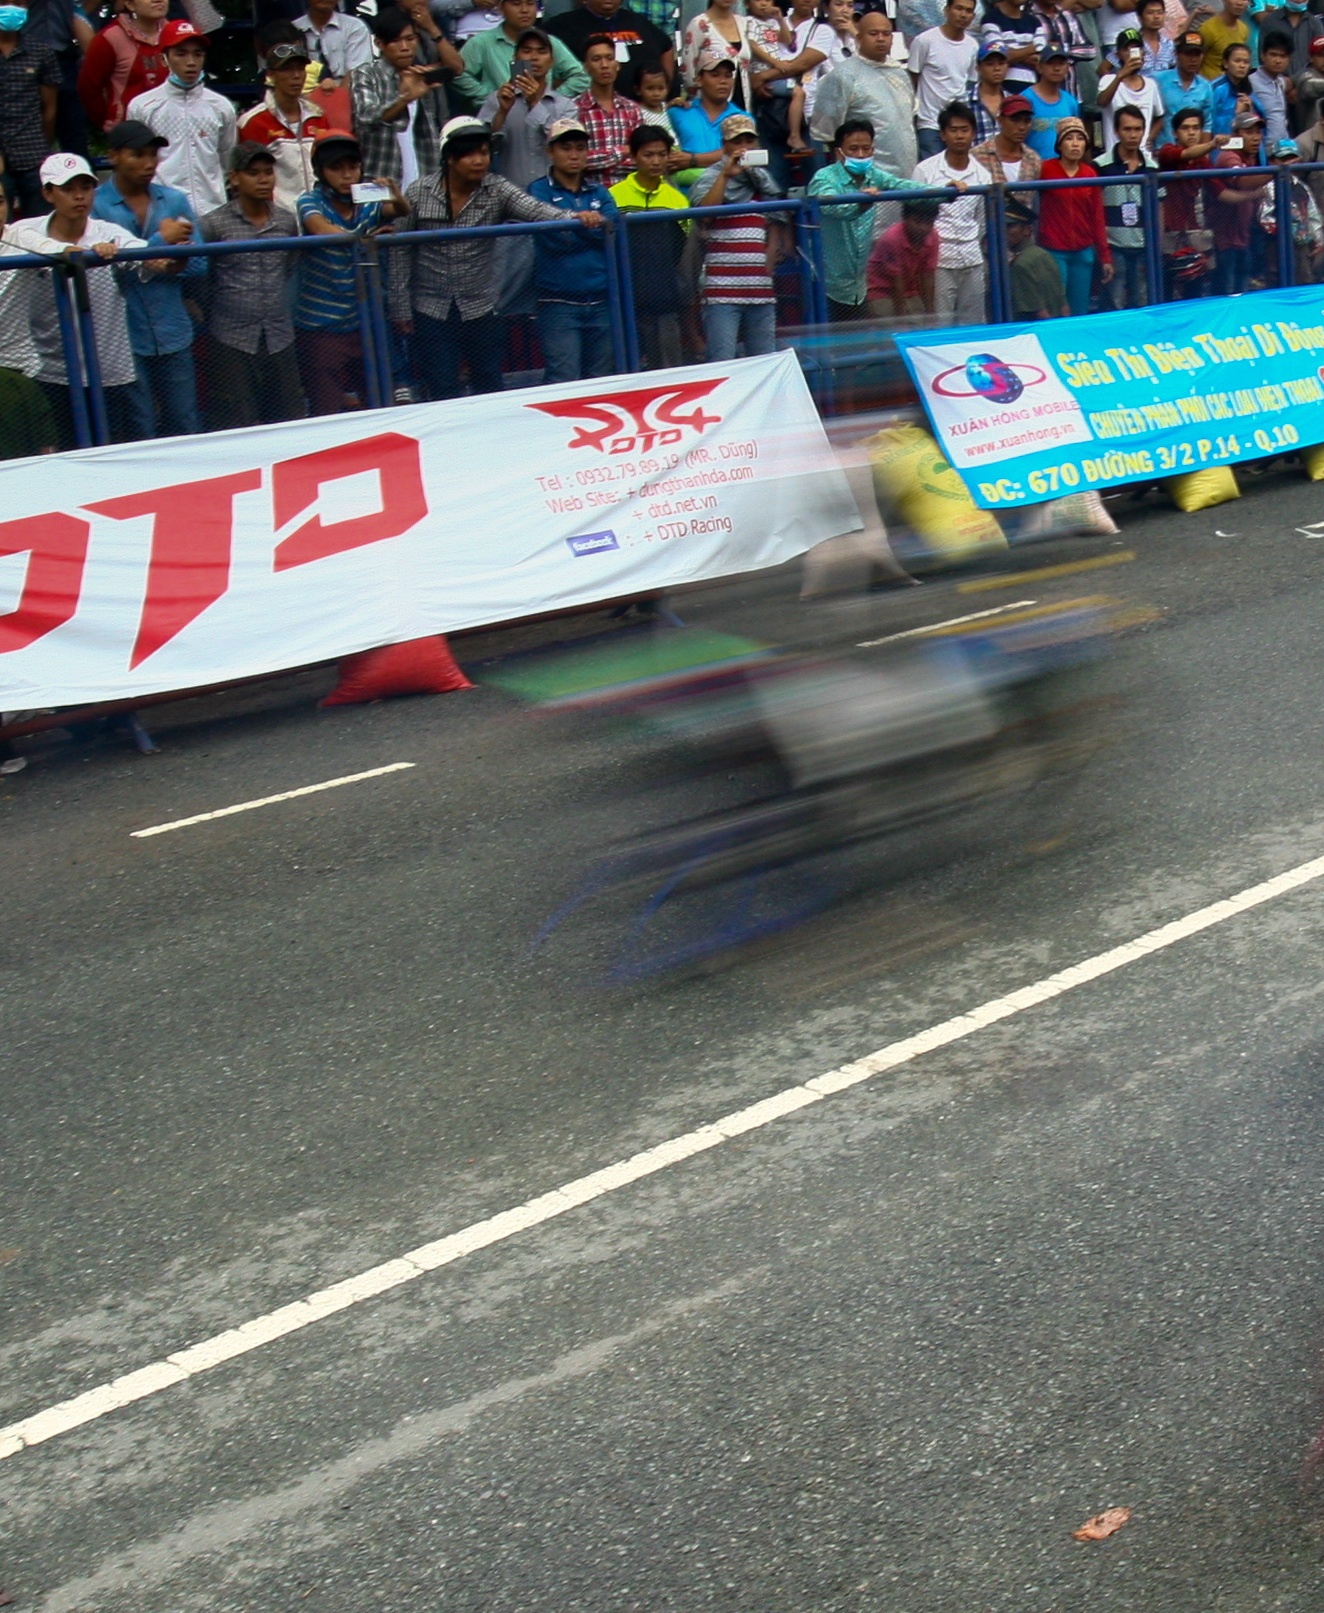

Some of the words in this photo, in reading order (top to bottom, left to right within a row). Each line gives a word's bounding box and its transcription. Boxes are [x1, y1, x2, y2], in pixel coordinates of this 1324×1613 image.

[1056, 352, 1116, 387] Siêu
[1104, 346, 1160, 384] Thị
[607, 428, 683, 456] DTD
[535, 475, 563, 493] Tel
[575, 453, 680, 487] 0932.79.89.19
[684, 446, 718, 469] (MR.
[1028, 462, 1080, 494] 670
[1160, 442, 1195, 469] 3/2
[1198, 433, 1242, 461] P.14
[1253, 423, 1300, 453] Q.10
[545, 493, 583, 514] Web
[648, 494, 719, 518] dtd.net.vn
[657, 522, 688, 541] DTD
[691, 515, 732, 537] Racing
